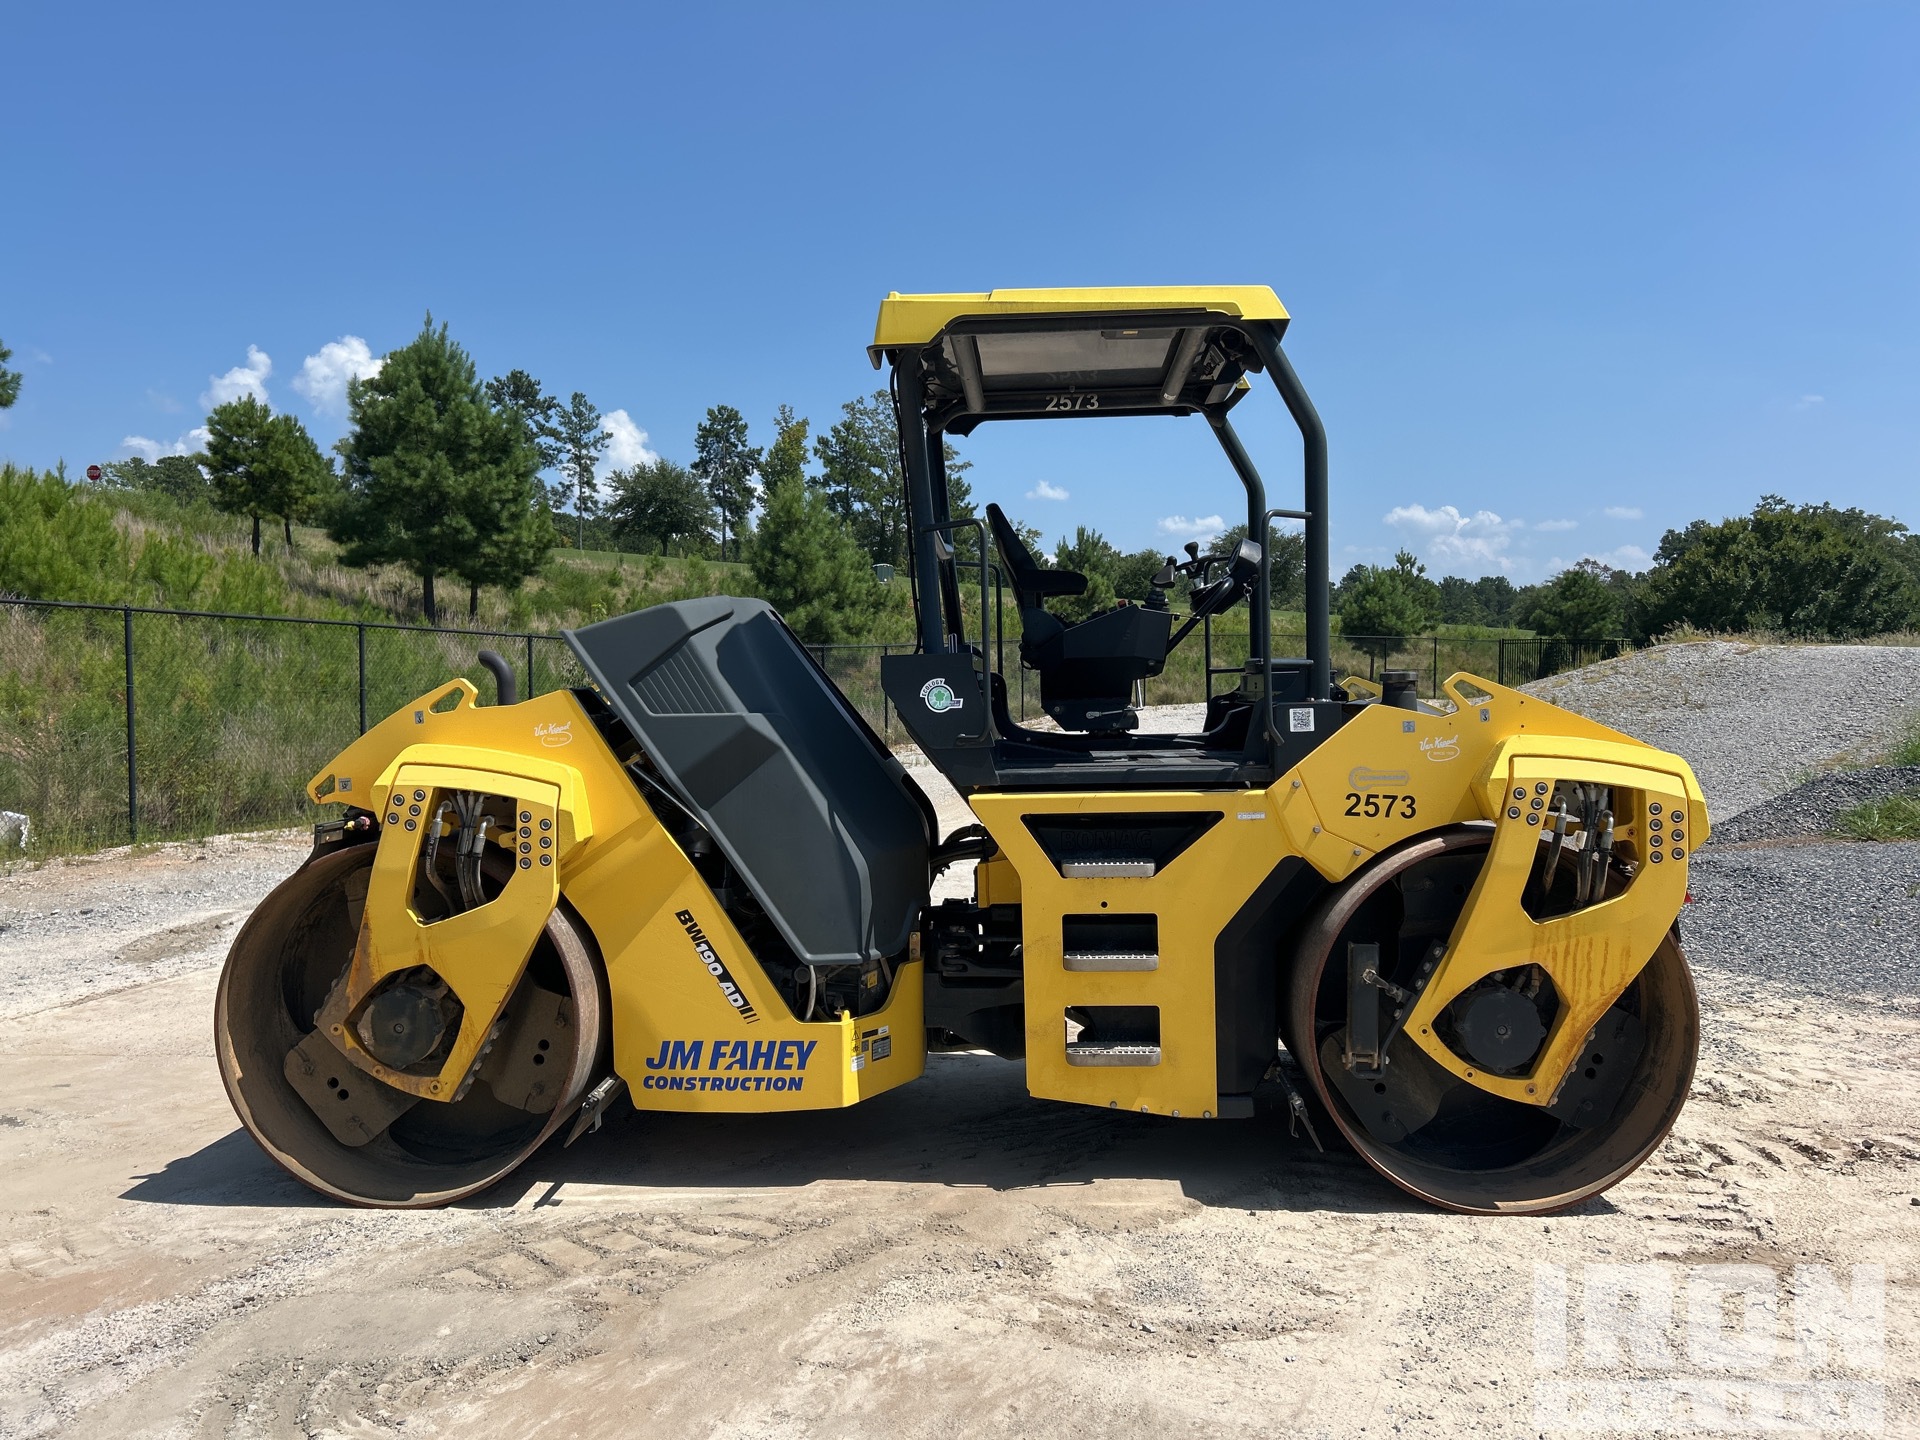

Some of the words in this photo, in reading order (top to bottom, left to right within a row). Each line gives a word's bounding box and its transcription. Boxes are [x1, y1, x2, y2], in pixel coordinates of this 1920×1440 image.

[1045, 393, 1099, 411] 2573
[921, 679, 944, 697] ECOLOGY
[1344, 792, 1417, 820] 2573
[1060, 829, 1153, 850] BOMAG
[645, 1040, 704, 1071] JM
[708, 1040, 819, 1071] FAHEY
[642, 1075, 804, 1092] CONSTRUCTION
